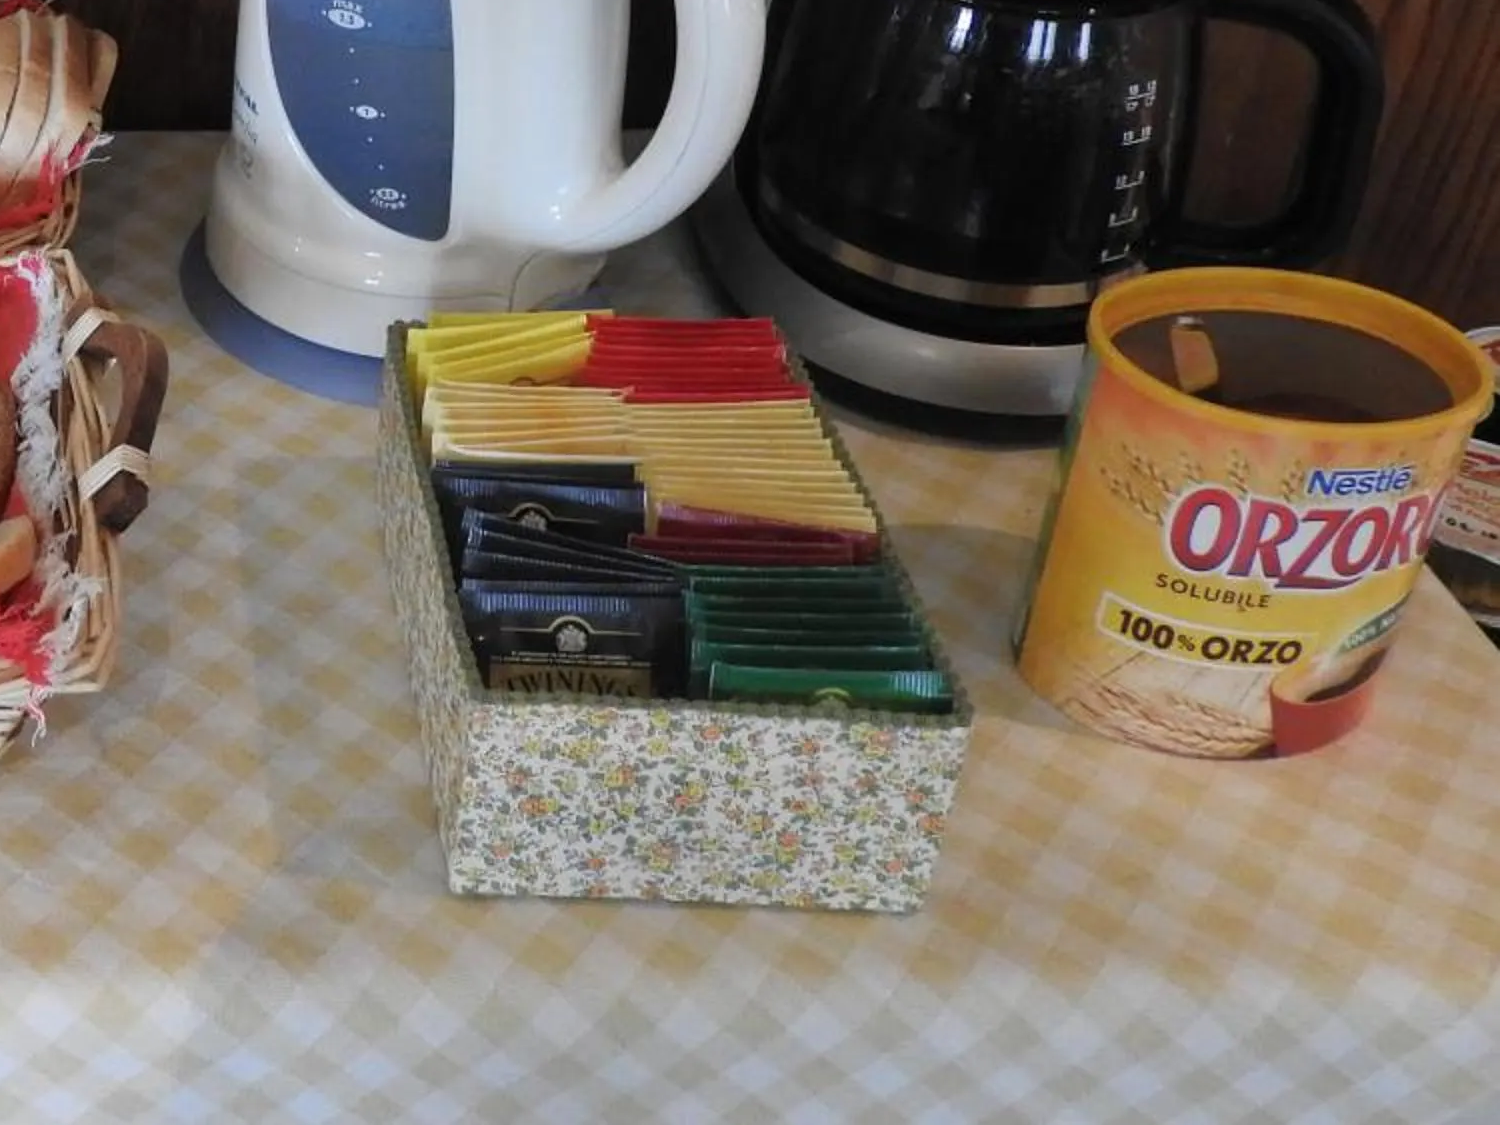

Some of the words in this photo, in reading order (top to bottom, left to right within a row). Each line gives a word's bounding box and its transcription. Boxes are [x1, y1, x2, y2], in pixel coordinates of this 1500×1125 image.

[1307, 465, 1415, 496] Nestlé
[1169, 487, 1438, 590] ORZOR
[1155, 572, 1272, 611] SOLUBILE
[1118, 608, 1196, 652] 100%
[1201, 635, 1303, 665] ORZO
